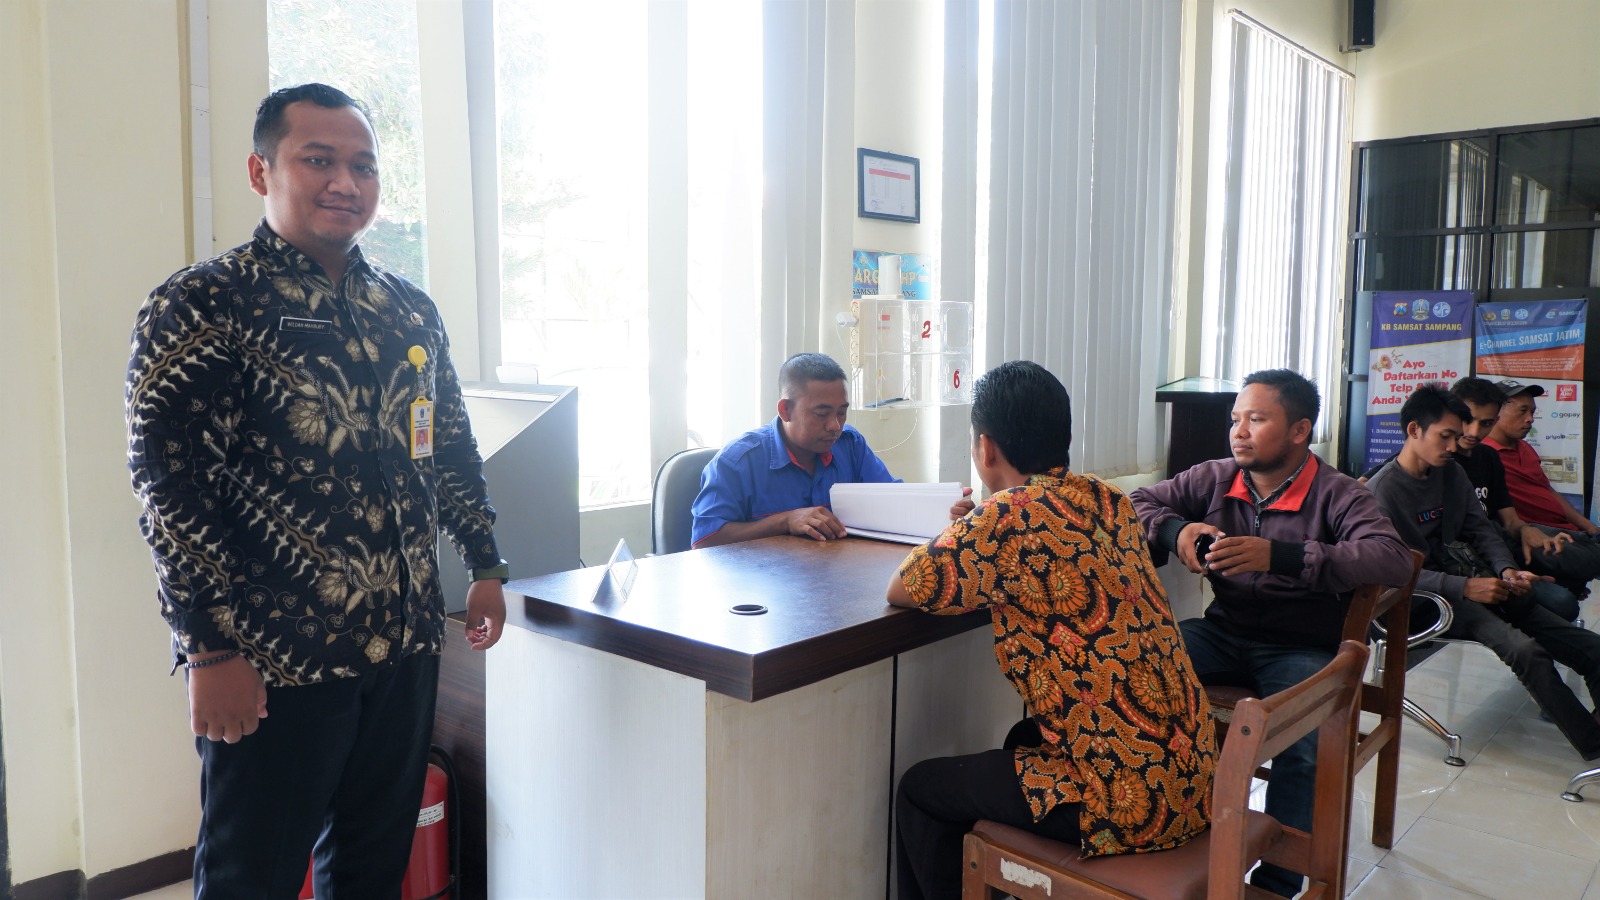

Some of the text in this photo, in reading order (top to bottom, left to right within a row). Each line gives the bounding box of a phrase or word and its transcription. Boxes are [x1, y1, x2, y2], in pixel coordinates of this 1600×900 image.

[921, 320, 931, 339] 2
[1381, 323, 1462, 331] KB SAMSAT SAMPANG
[1519, 332, 1553, 346] SAMSAT
[1556, 329, 1580, 342] JATIM
[1402, 360, 1425, 370] Ayo
[953, 369, 960, 389] 6
[1384, 370, 1457, 381] Daftarkan No
[1390, 383, 1413, 394] Telp
[1372, 396, 1401, 405] Anda
[1418, 507, 1444, 522] LUC
